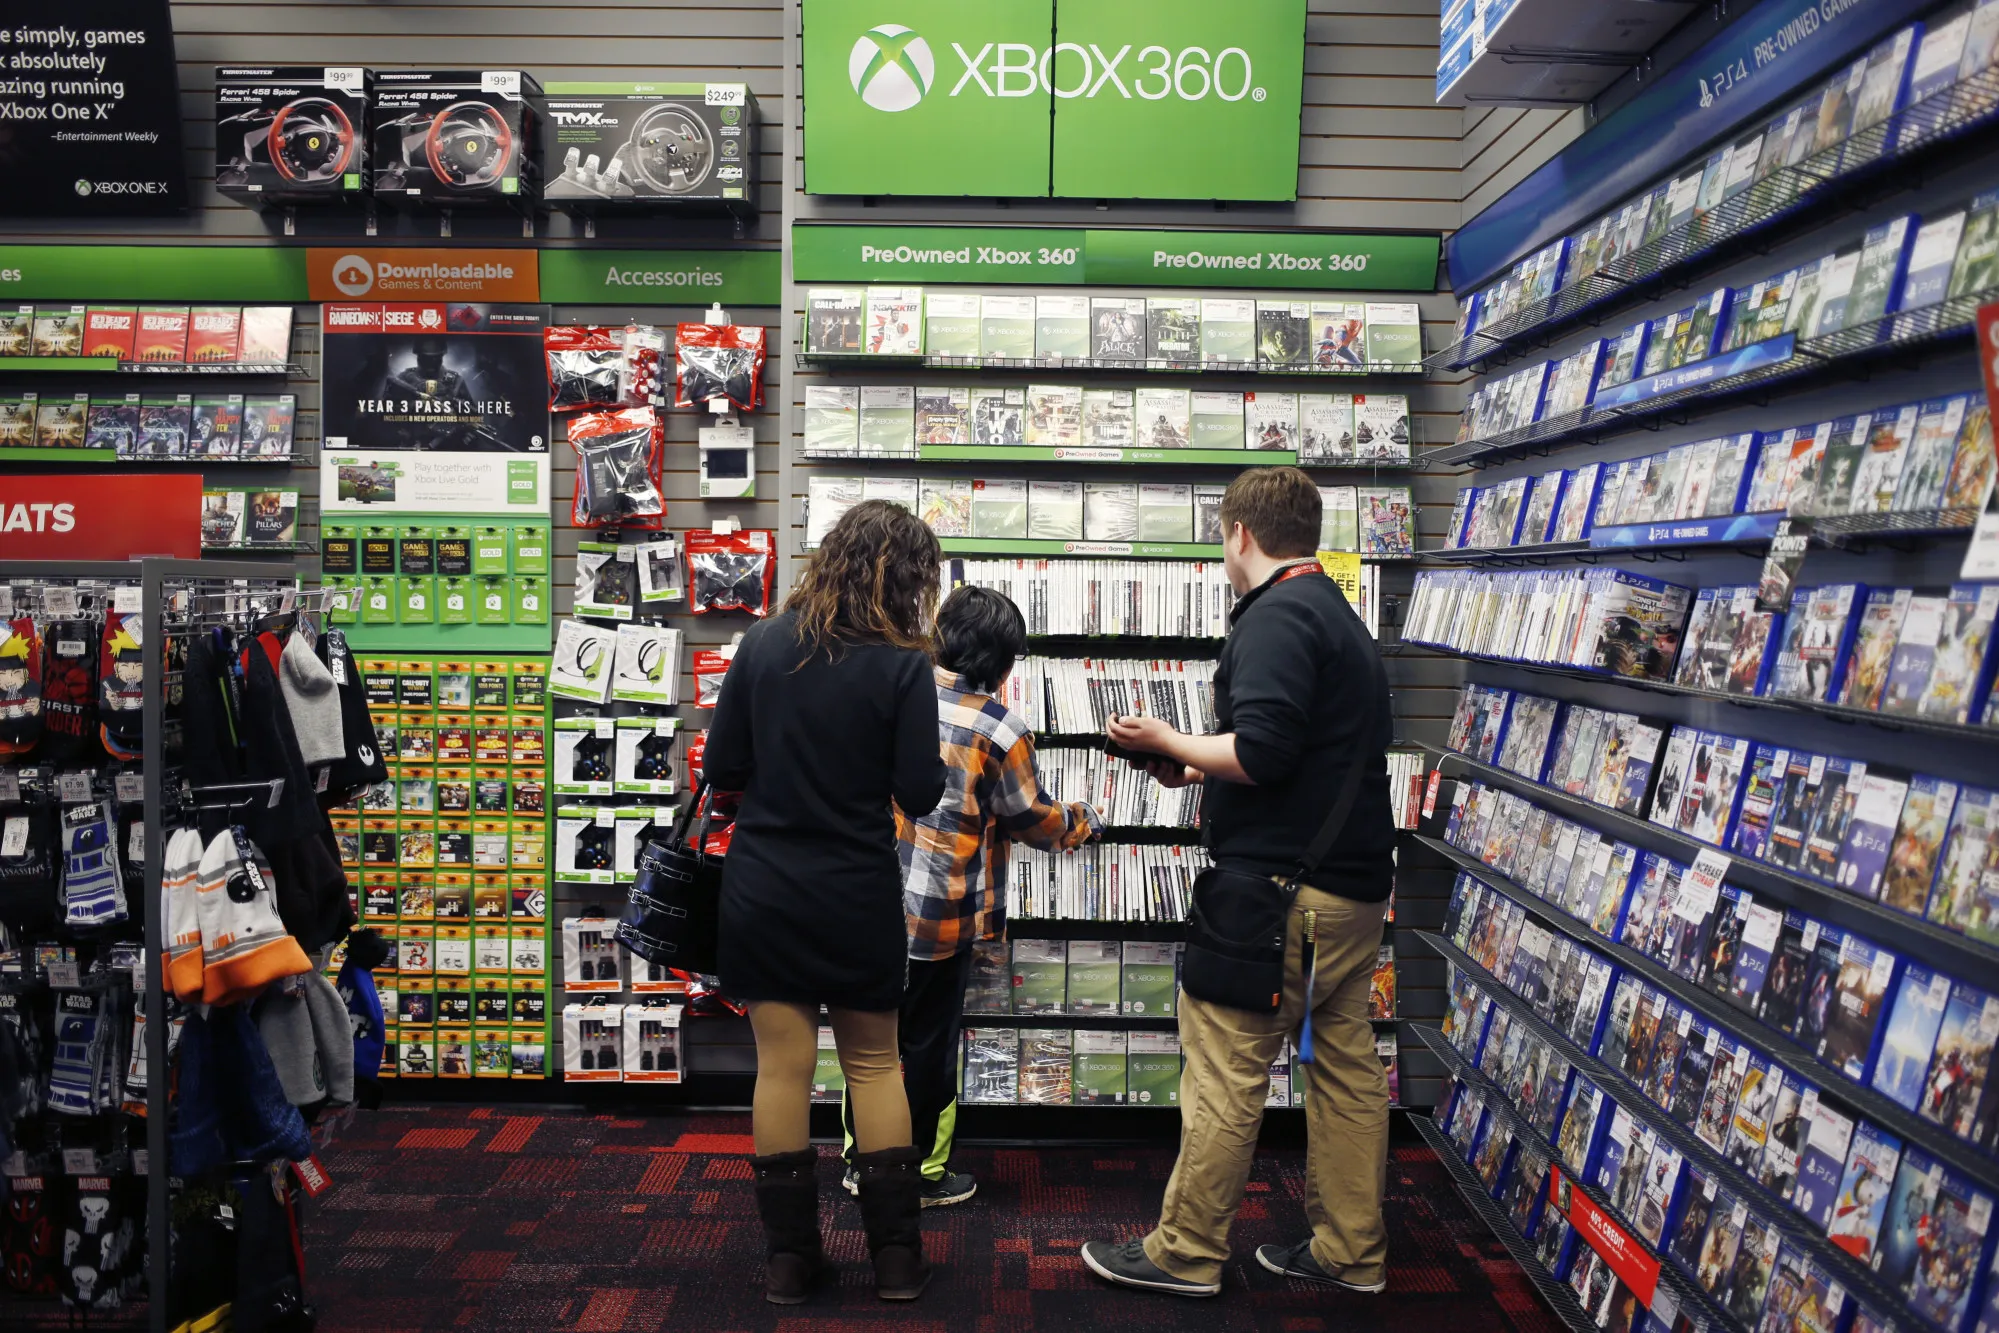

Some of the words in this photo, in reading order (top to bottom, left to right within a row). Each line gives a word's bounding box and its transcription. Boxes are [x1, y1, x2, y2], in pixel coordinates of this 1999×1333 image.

[16, 26, 80, 48] simply,
[84, 30, 146, 48] games
[1755, 1, 1820, 69] PRE-OWNED
[10, 51, 107, 74] absolutely
[1713, 58, 1749, 97] PS4
[51, 77, 125, 99] running
[221, 88, 250, 96] Ferrari
[252, 88, 271, 96] 458
[273, 88, 300, 97] Spider
[410, 92, 428, 100] 458
[0, 102, 48, 120] Xbox
[51, 102, 91, 120] One
[549, 112, 604, 125] TMX
[124, 132, 159, 144] Weekly
[94, 182, 129, 194] XBOX
[130, 182, 157, 194] ONE
[158, 182, 169, 194] X
[861, 245, 971, 266] PreOwned
[976, 246, 1033, 266] Xbox
[1153, 250, 1263, 271] PreOwned
[1267, 252, 1324, 272] Xbox
[378, 262, 514, 280] Downloadable
[605, 266, 724, 287] Accessories
[378, 279, 421, 291] Games
[423, 279, 433, 290] &
[435, 279, 484, 291] Content
[385, 311, 415, 326] SIEGE
[358, 400, 394, 413] YEAR
[401, 400, 409, 413] 3
[415, 400, 451, 413] PASS
[458, 401, 472, 413] IS
[477, 401, 511, 414] HERE
[414, 462, 432, 473] Play
[434, 462, 470, 473] together
[472, 462, 492, 472] with
[414, 475, 436, 484] Xbox
[438, 475, 455, 484] Live
[457, 475, 479, 484] Gold
[0, 502, 75, 533] ATS
[256, 520, 283, 529] PILLARS
[1772, 535, 1808, 551] POINTS
[1629, 577, 1650, 589] PS4
[1863, 837, 1886, 852] PS4
[1748, 958, 1765, 973] PS4
[298, 1158, 327, 1193] MARVEL
[1815, 1168, 1836, 1187] PS4
[12, 1177, 43, 1191] MARVEL
[78, 1177, 110, 1191] MARVEL
[1603, 1222, 1626, 1251] CREDIT
